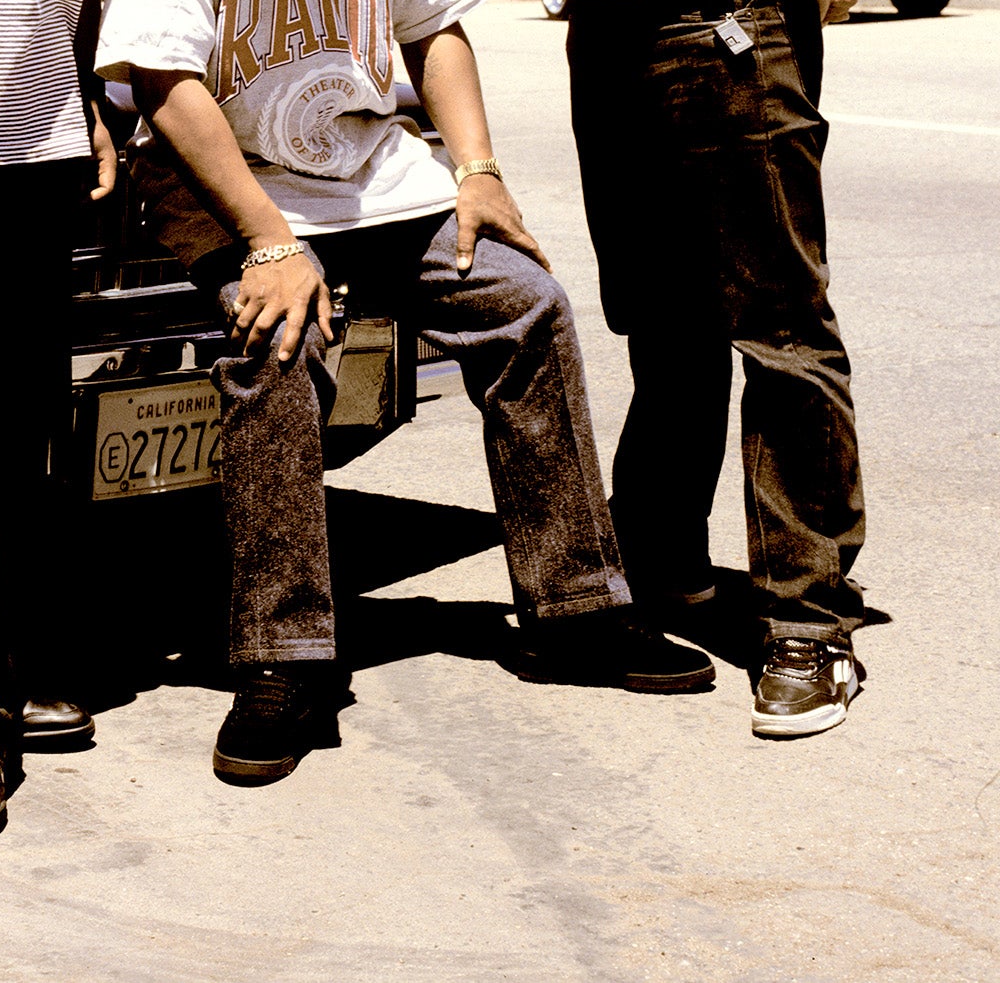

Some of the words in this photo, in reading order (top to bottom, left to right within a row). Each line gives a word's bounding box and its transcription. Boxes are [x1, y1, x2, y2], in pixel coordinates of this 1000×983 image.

[299, 78, 356, 104] THEATER
[291, 137, 310, 155] OF
[137, 394, 216, 420] CALIFORNIA
